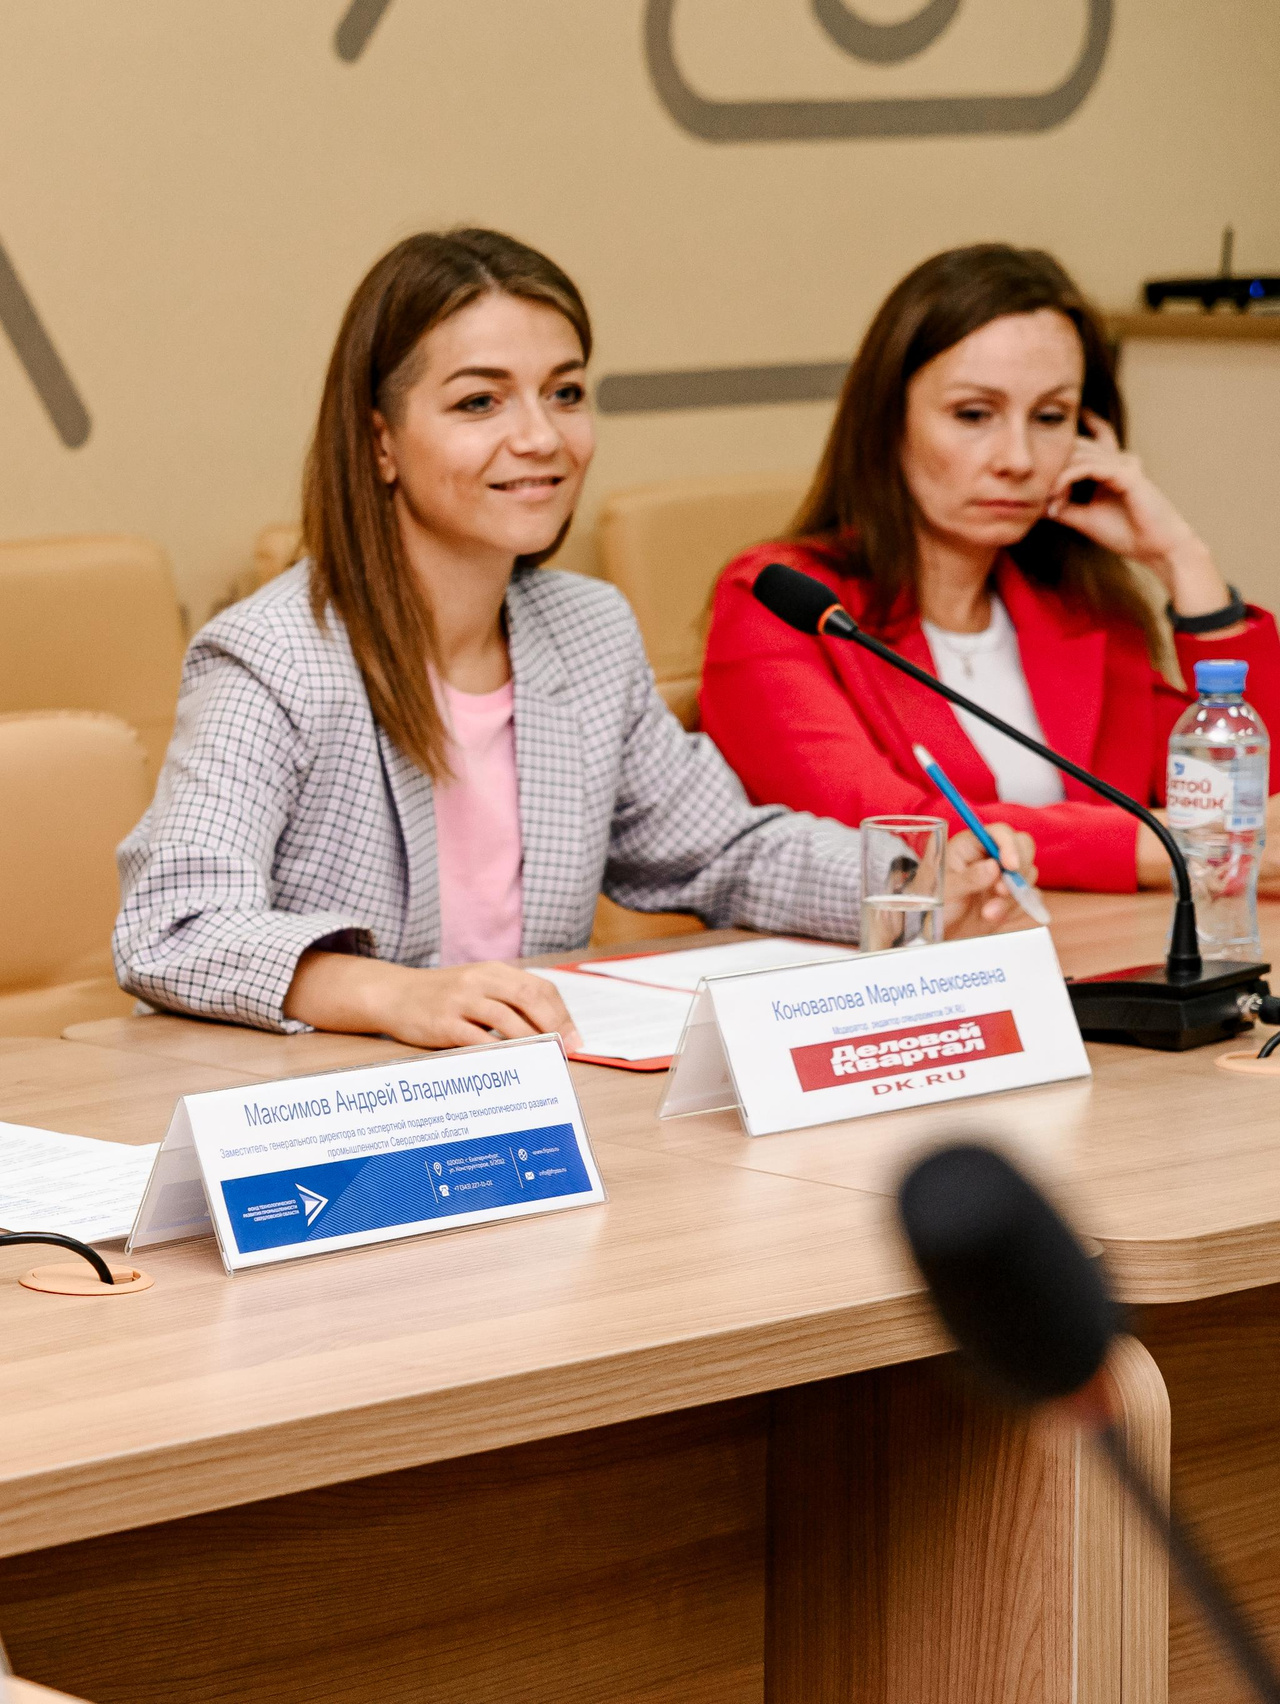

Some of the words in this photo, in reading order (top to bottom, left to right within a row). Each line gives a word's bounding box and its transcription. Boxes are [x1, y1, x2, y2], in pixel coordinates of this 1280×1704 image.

[771, 990, 865, 1021] Коновалова
[866, 982, 918, 1007] Мария
[920, 967, 1006, 996] Алексеевна
[830, 1021, 982, 1064] Деловой
[244, 1098, 331, 1127] Максимов
[336, 1082, 398, 1113] Андрей
[399, 1068, 521, 1102] Владимирович
[872, 1069, 967, 1096] DK.RU
[220, 1143, 269, 1159] Заместитель
[269, 1136, 318, 1152] генерального
[319, 1128, 356, 1144] директора
[356, 1127, 366, 1137] по
[367, 1119, 407, 1136] экспертной
[407, 1114, 445, 1130] поддержке
[445, 1110, 469, 1123] Фонда
[469, 1102, 528, 1118] технологического
[528, 1096, 559, 1112] развития
[327, 1140, 390, 1158] промышленности
[390, 1130, 441, 1149] Свердловской
[441, 1126, 470, 1140] области
